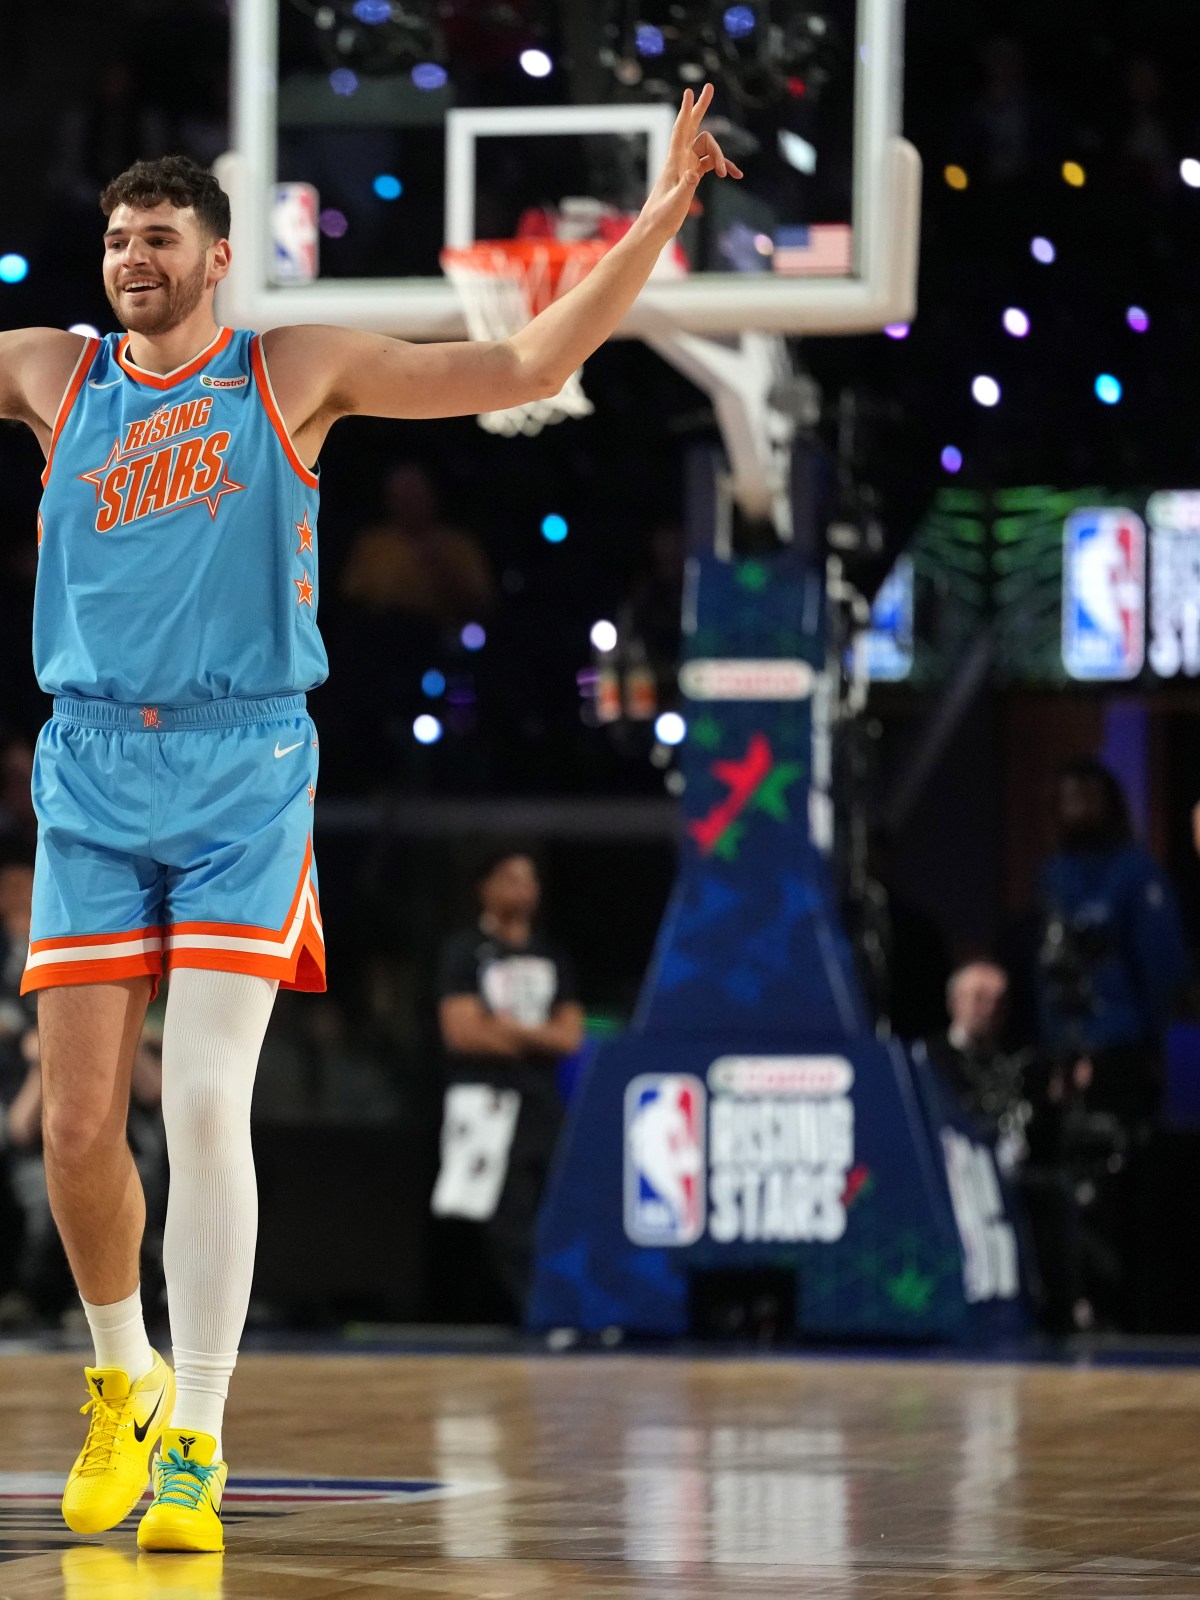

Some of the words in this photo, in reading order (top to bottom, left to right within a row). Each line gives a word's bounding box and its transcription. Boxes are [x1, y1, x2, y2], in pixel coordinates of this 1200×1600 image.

[213, 377, 246, 387] Castrol
[124, 397, 213, 452] RISING
[95, 431, 231, 533] STARS
